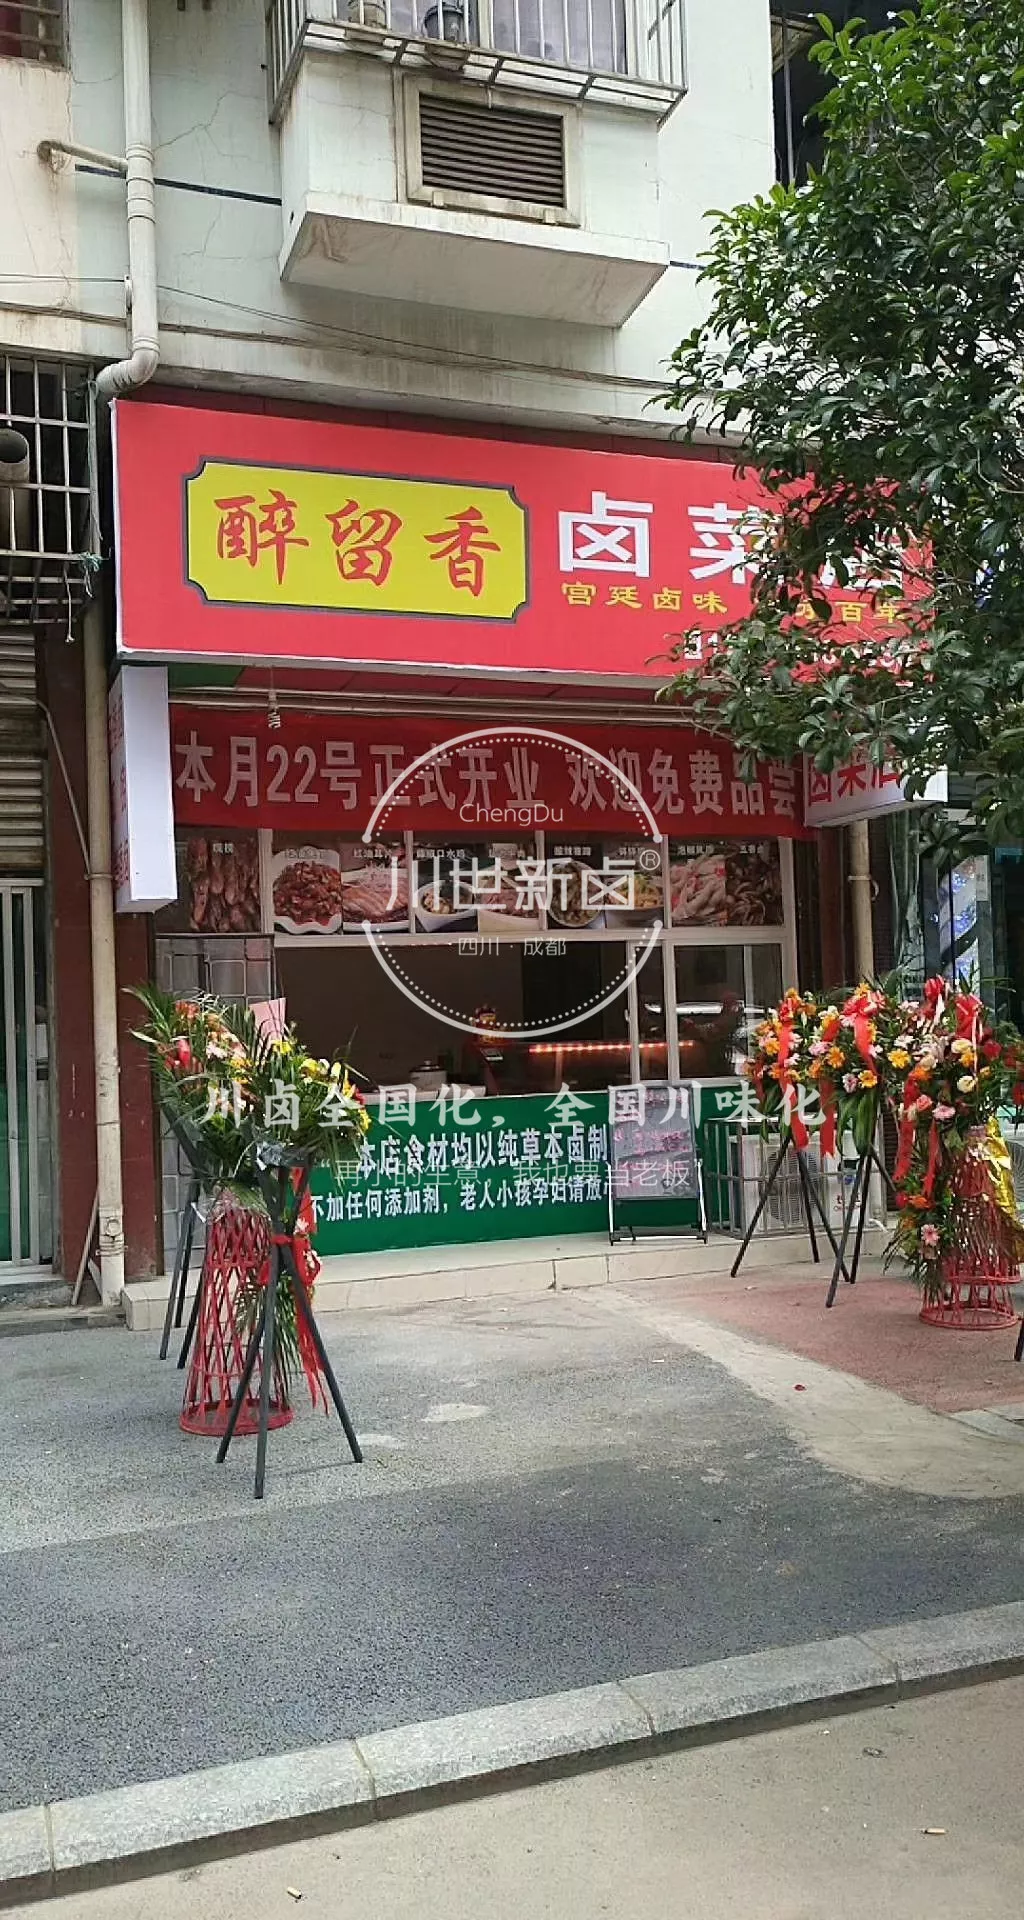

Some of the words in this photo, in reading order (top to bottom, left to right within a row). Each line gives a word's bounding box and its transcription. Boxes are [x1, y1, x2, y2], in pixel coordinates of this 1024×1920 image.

[214, 489, 501, 597] 醉留香
[561, 581, 728, 614] 宫廷卤味
[175, 731, 544, 811] 本月22号正式开业
[565, 748, 797, 817] 欢迎免费品尝
[311, 1174, 613, 1222] 不加任何添加剂，老人小孩孕妇请放
